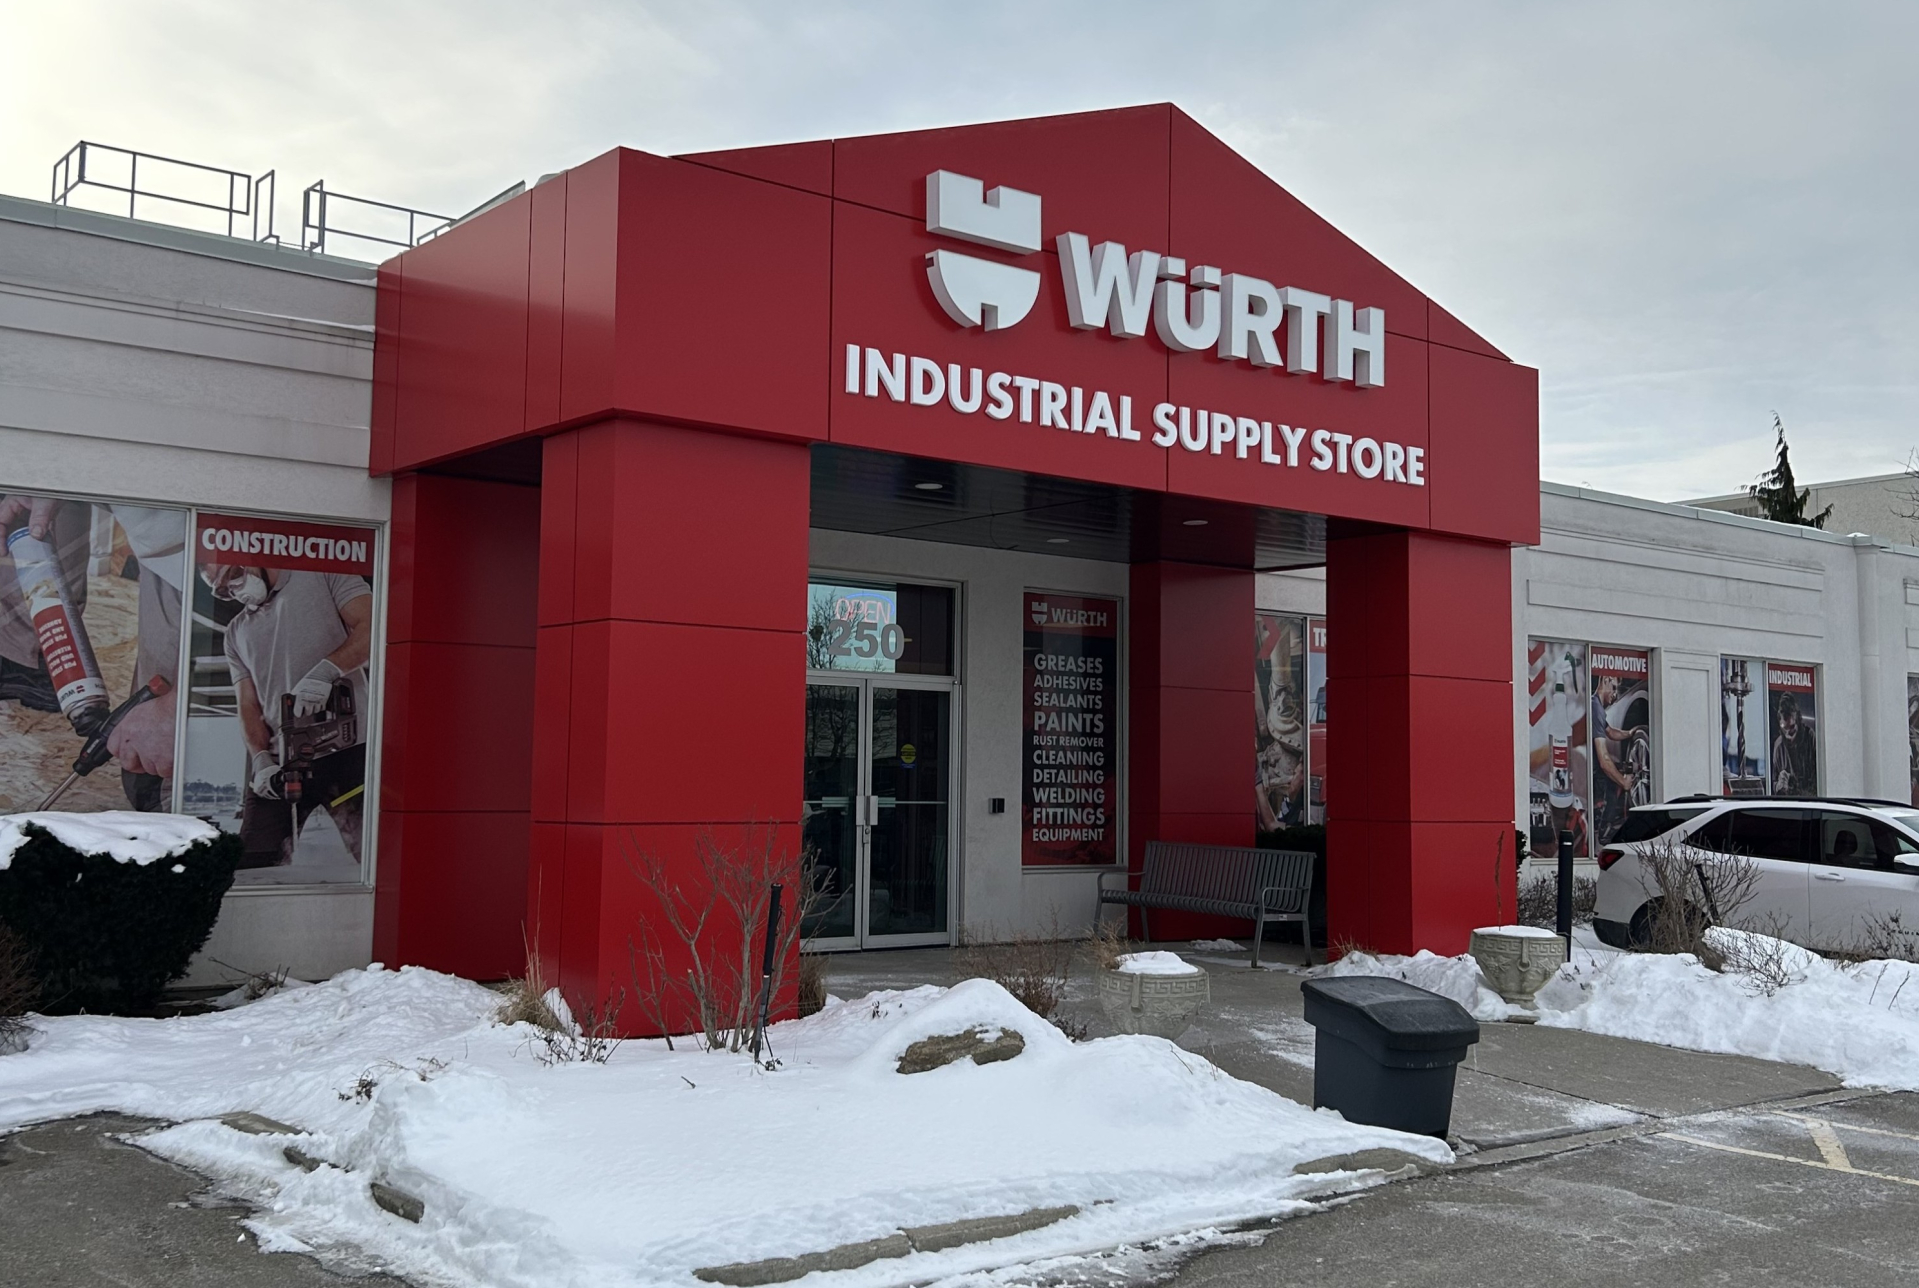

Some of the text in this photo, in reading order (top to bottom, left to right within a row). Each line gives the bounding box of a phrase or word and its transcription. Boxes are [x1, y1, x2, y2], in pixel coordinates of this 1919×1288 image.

[1056, 231, 1385, 389] WÜRTH
[845, 343, 1425, 486] INDUSTRIAL SUPPLY STORE
[202, 527, 367, 563] CONSTRUCTION
[835, 597, 891, 624] OPEN
[1051, 607, 1107, 627] WÜRTH
[828, 619, 905, 660] 250
[1033, 653, 1104, 674] GREASES
[1591, 653, 1647, 673] AUTOMOTIVE
[1033, 674, 1104, 691] ADHESIVES
[1768, 669, 1812, 687] INDUSTRIAL
[1033, 692, 1103, 710] SEALANTS
[1034, 711, 1104, 733] PAINTS
[1033, 735, 1104, 747] RUST REMOVER
[1033, 750, 1105, 767] CLEANING
[1033, 768, 1105, 785] DETAILING
[1033, 787, 1105, 804] WELDING
[1033, 807, 1105, 825] FITTINGS
[1032, 828, 1105, 842] EQUIPMENT
